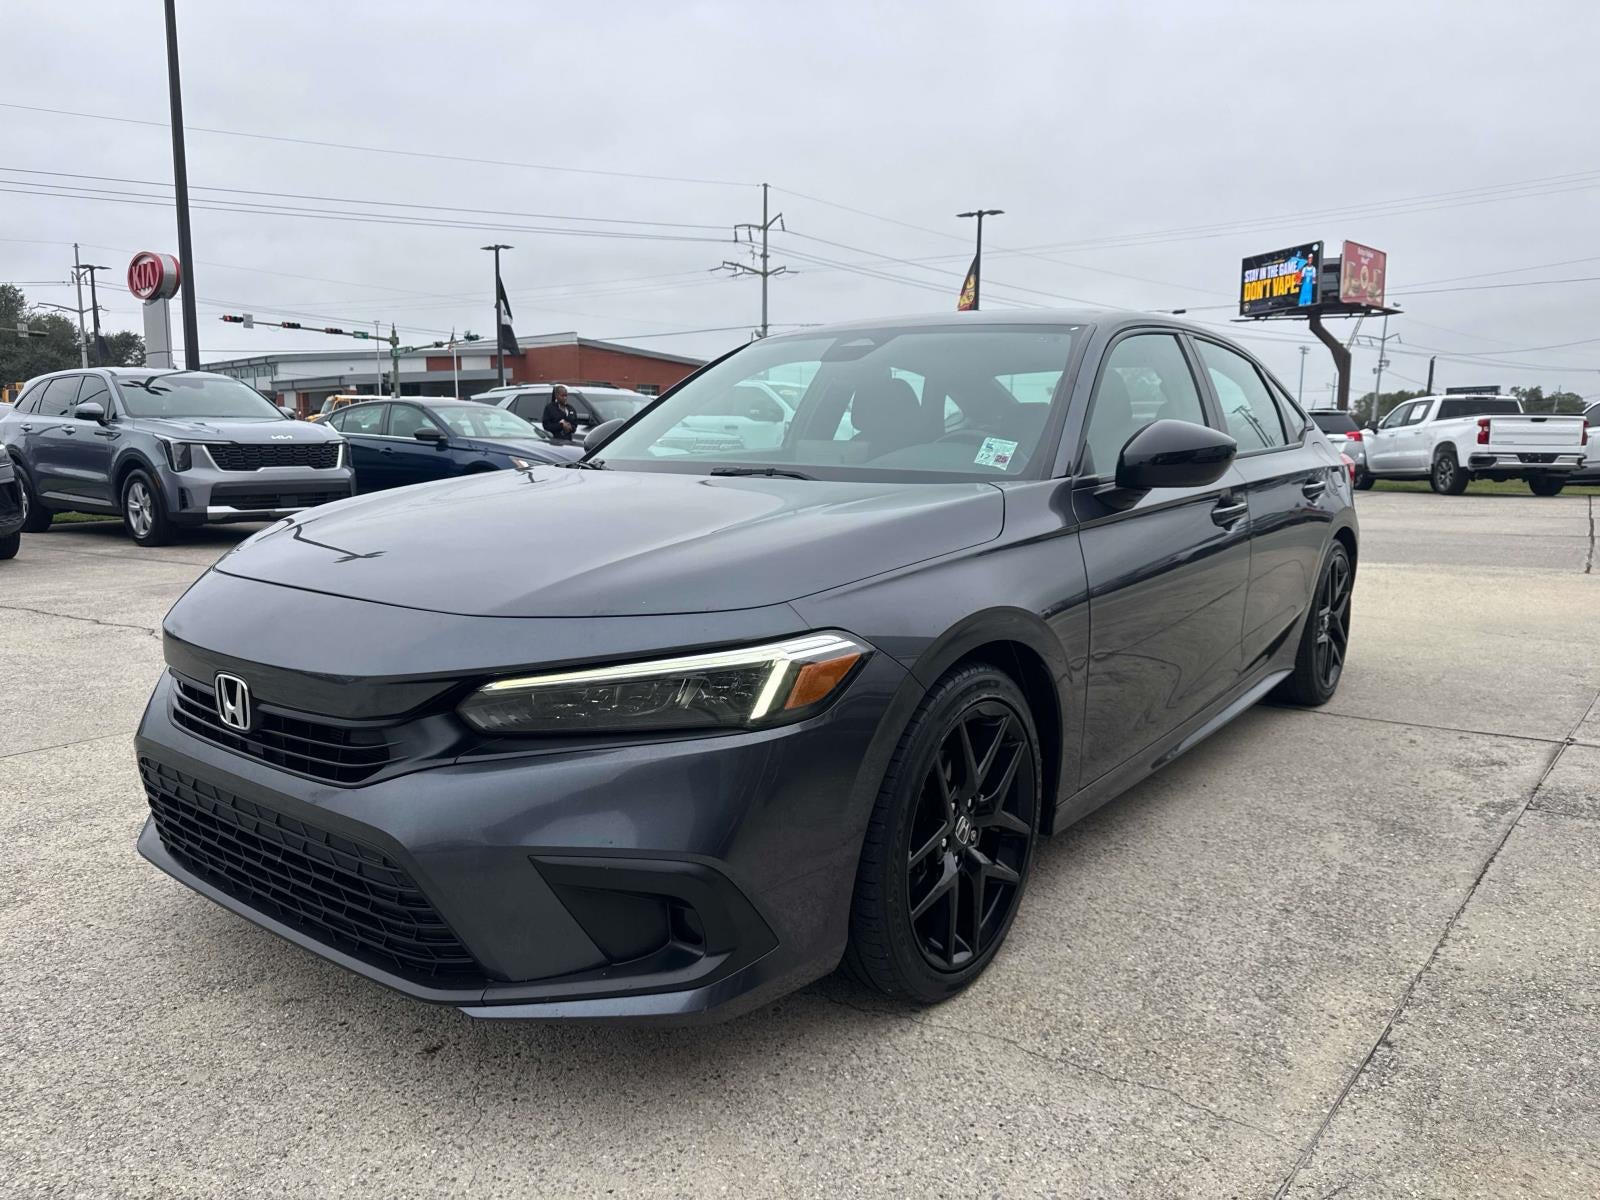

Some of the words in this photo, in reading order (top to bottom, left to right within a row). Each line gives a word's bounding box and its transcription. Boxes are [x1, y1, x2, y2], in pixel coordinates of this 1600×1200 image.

[131, 261, 155, 291] KIA
[1244, 267, 1259, 283] STAY
[1267, 264, 1279, 279] THE
[1244, 279, 1271, 301] DON'T
